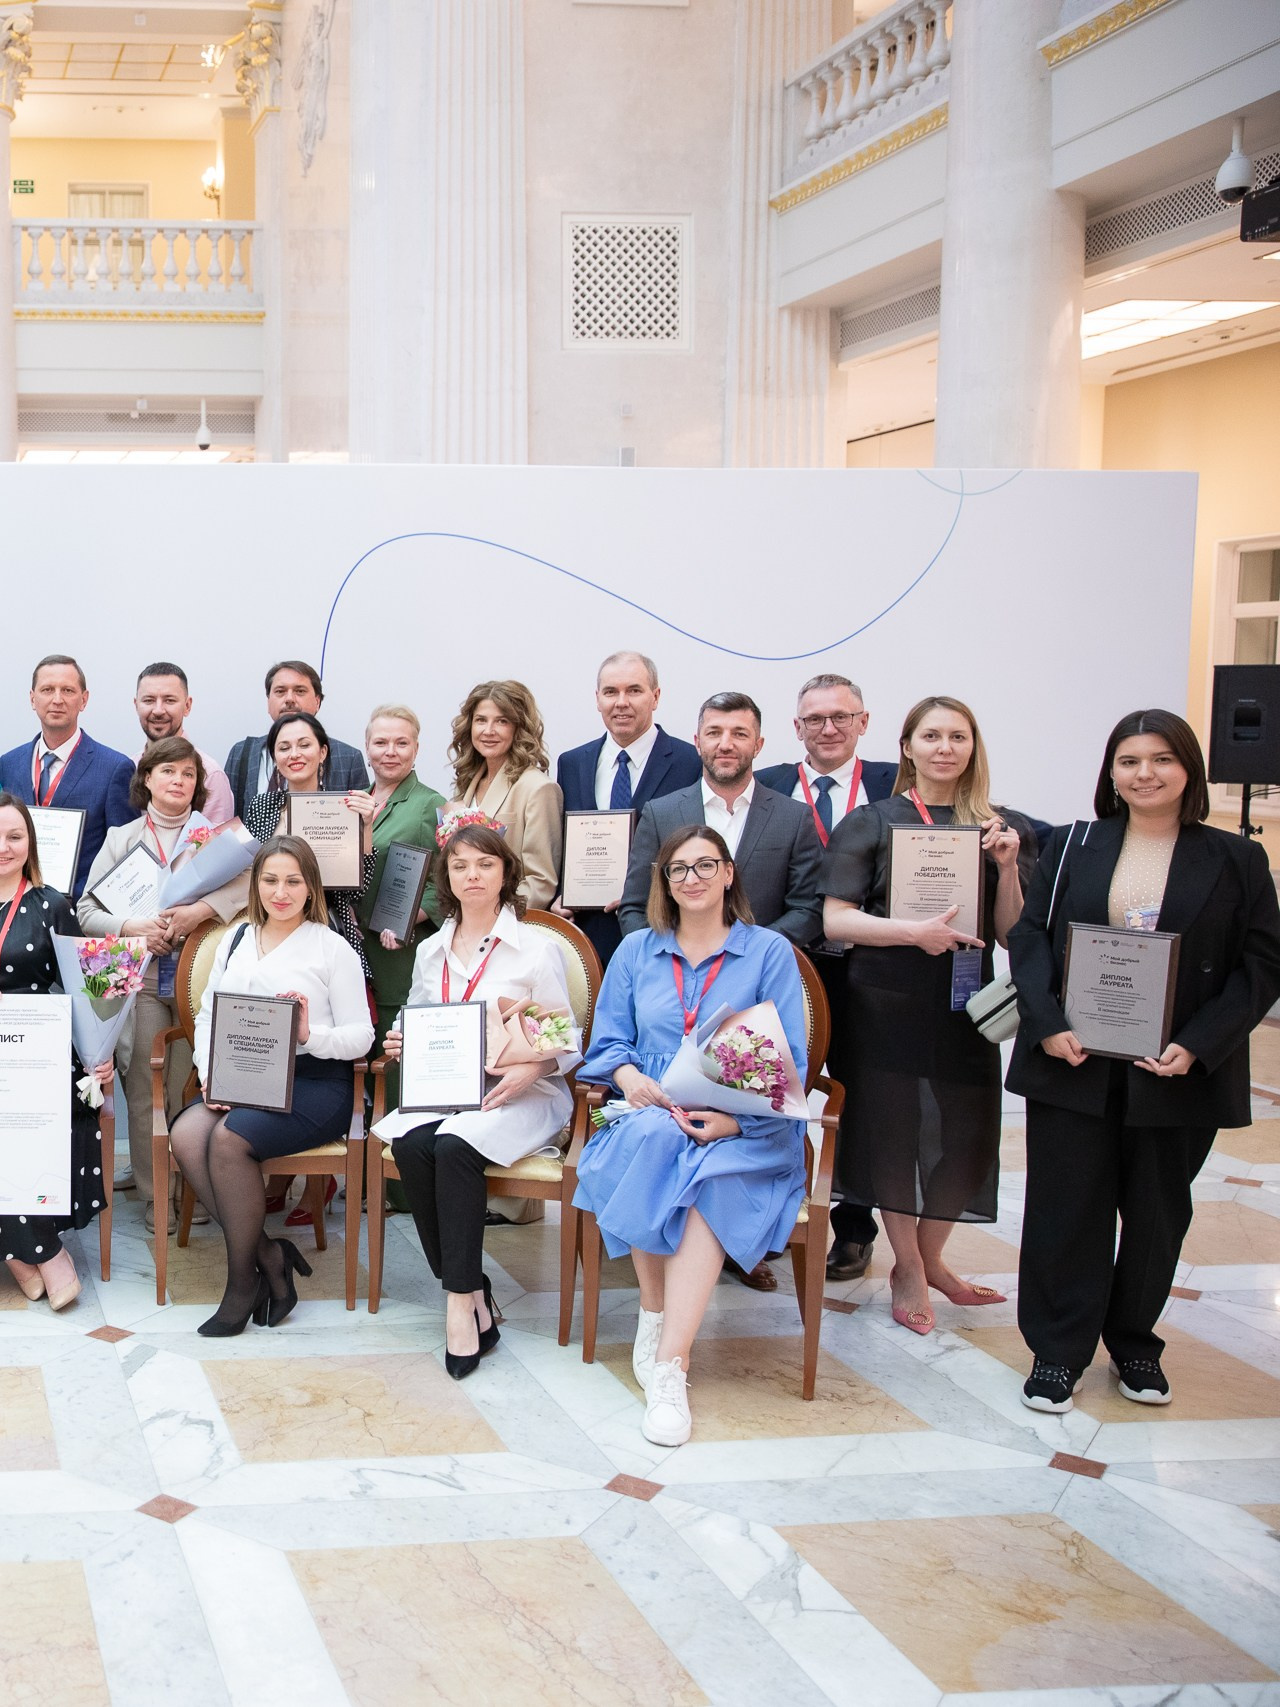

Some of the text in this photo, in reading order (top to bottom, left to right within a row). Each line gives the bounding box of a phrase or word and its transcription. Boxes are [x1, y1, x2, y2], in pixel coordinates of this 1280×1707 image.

[1100, 974, 1132, 982] ДИПЛОМ
[1099, 980, 1134, 989] ЛАУРЕАТА
[252, 1036, 278, 1044] ЛАУРЕАТА
[234, 1040, 274, 1050] СПЕЦИАЛЬНОЙ
[234, 1046, 270, 1054] НОМИНАЦИИ
